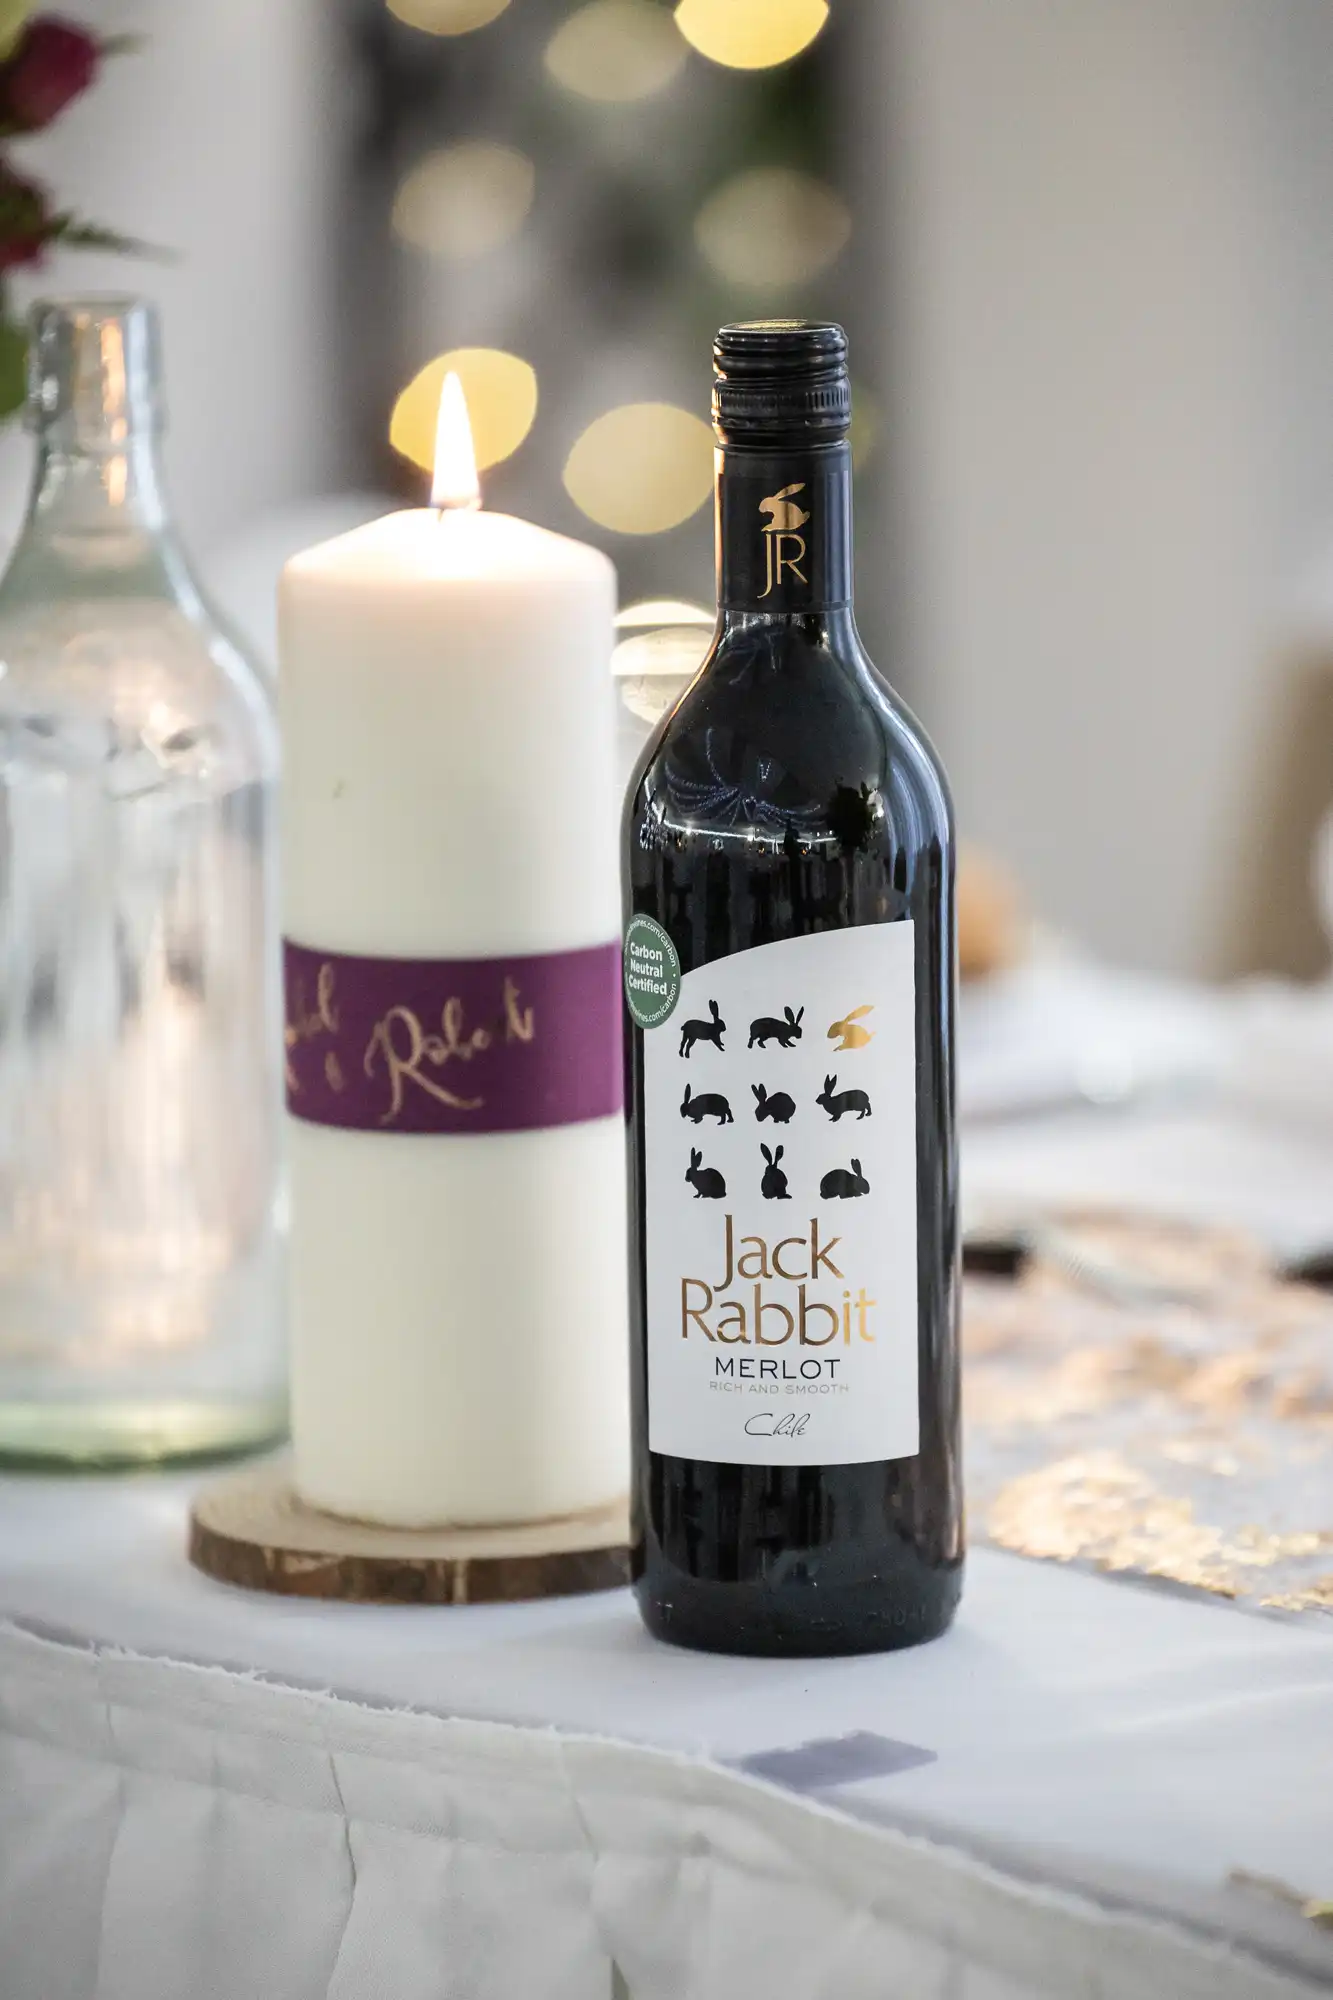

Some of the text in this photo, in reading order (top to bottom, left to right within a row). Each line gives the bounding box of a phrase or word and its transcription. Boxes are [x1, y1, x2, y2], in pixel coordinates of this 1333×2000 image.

[757, 533, 808, 599] JR
[630, 942, 663, 962] Carbon
[630, 958, 663, 978] Neutral
[628, 974, 668, 996] Certified
[713, 1214, 845, 1293] Jack
[680, 1276, 878, 1346] Rabbit
[715, 1357, 841, 1380] MERLOT
[709, 1381, 850, 1395] RICH AND SMOOTH
[743, 1413, 811, 1438] Chile
